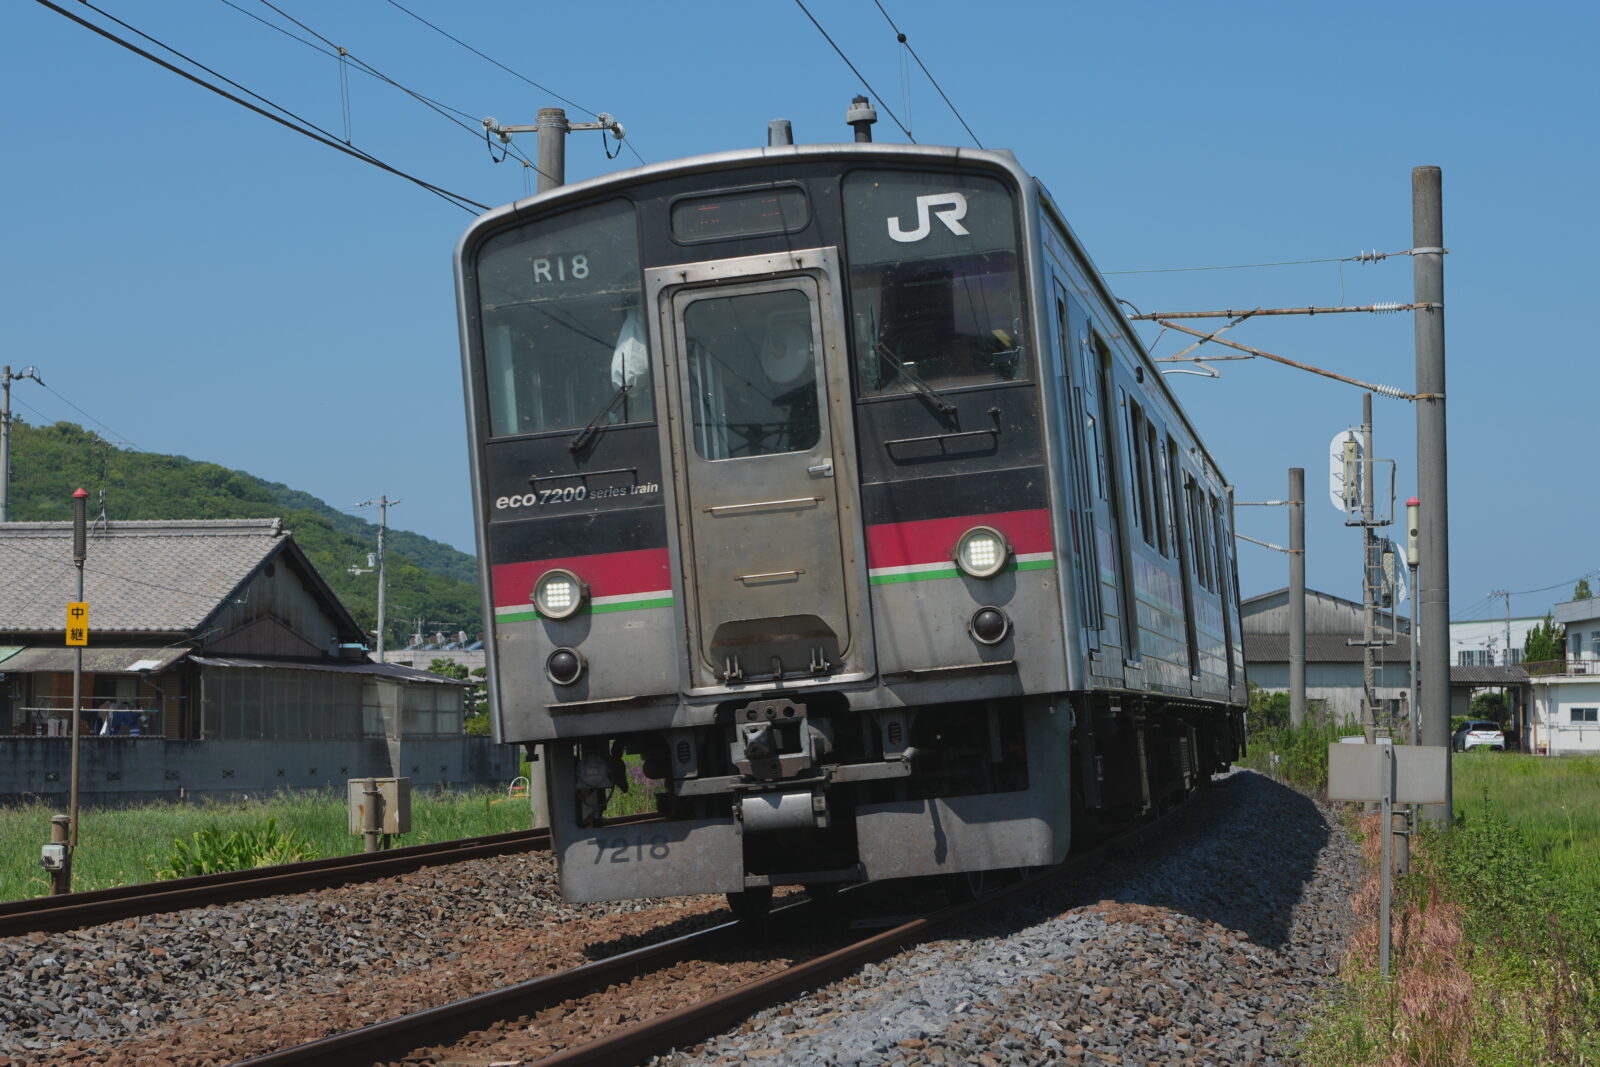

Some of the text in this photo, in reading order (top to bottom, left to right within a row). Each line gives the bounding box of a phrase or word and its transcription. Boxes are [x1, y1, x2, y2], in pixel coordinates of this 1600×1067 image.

[887, 192, 970, 242] JR
[533, 254, 590, 283] R18
[496, 482, 659, 509] eco 7200 series train
[587, 834, 671, 865] 7218
